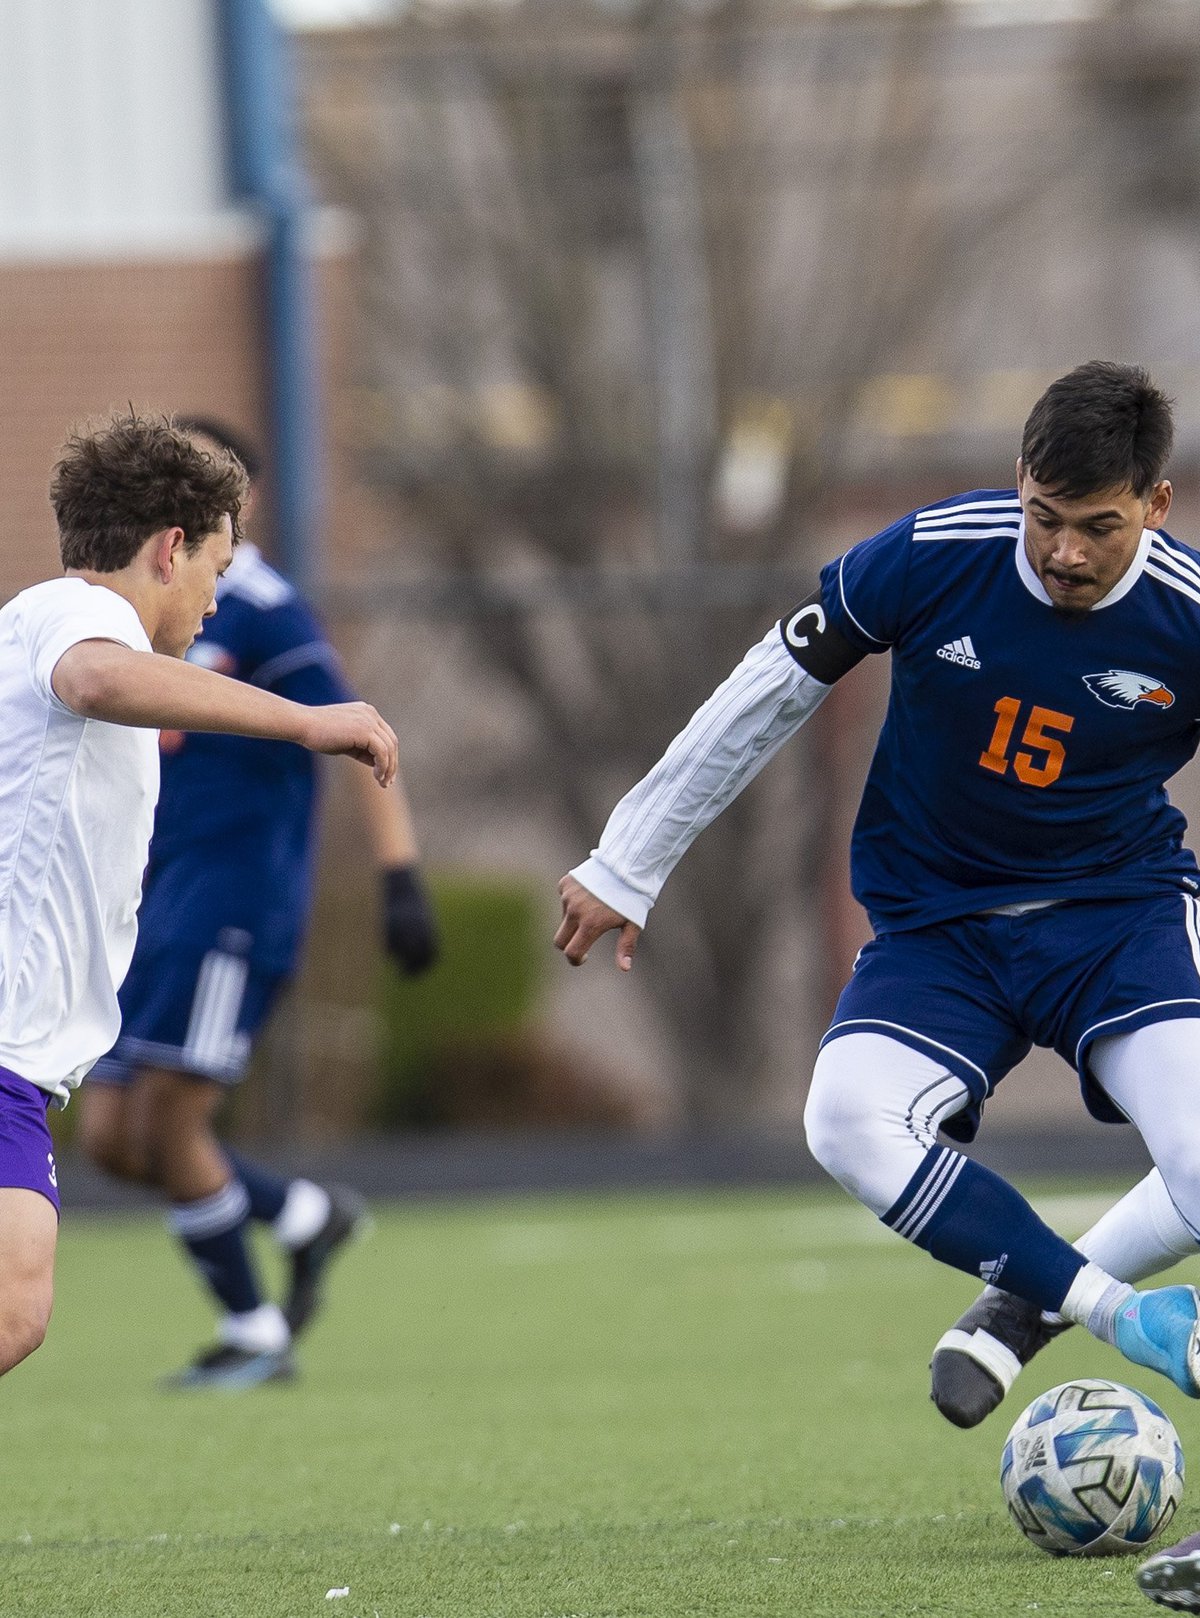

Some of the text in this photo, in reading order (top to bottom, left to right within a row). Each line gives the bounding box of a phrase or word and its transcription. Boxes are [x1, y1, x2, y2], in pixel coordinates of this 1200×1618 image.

[786, 604, 826, 647] C
[936, 648, 982, 670] adidas
[979, 696, 1075, 788] 15
